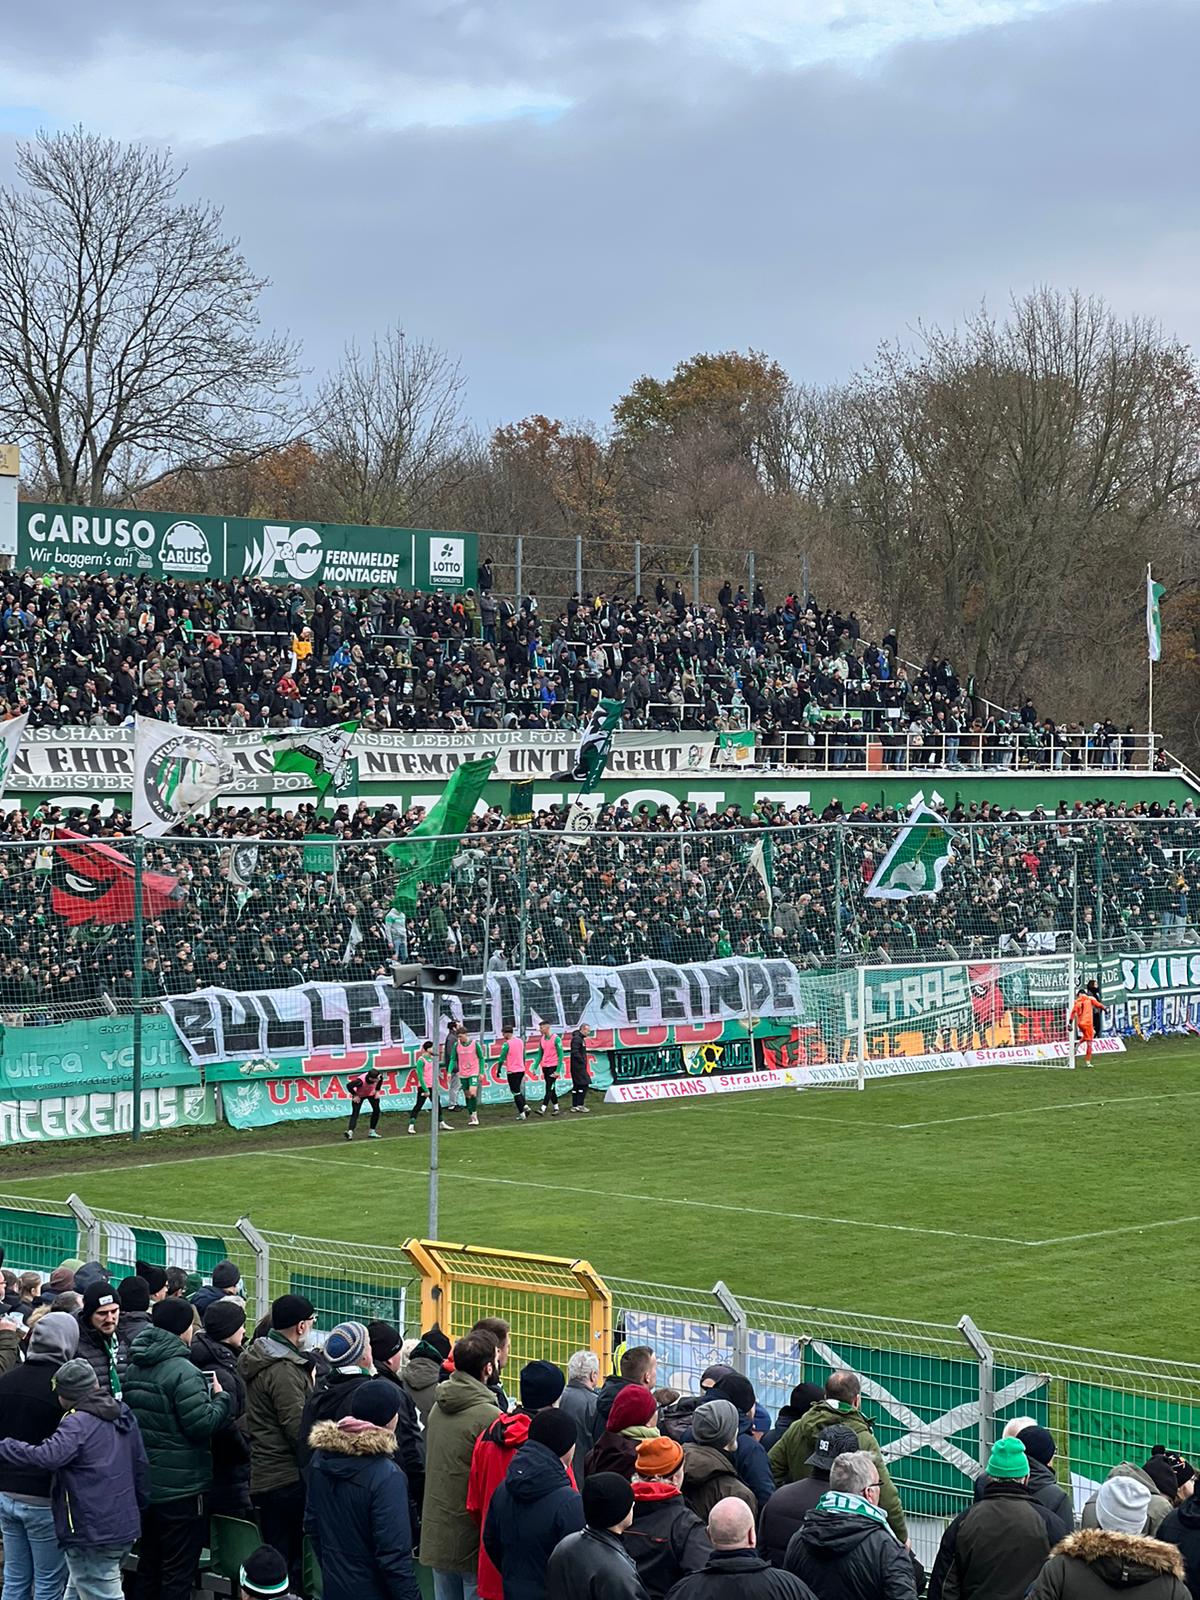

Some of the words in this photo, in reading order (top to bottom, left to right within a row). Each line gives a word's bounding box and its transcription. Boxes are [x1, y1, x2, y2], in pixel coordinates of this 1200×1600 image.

[28, 513, 155, 549] CARUSO
[29, 546, 51, 563] Wir
[114, 554, 133, 567] an!
[158, 550, 212, 565] CARUSO
[325, 550, 400, 568] FERNMELDE
[322, 568, 398, 584] MONTAGEN
[433, 561, 461, 573] LOTTO
[20, 727, 132, 741] NSCHAFT
[353, 733, 407, 747] NSER
[412, 733, 476, 747] LEBEN
[482, 732, 524, 746] NUR
[45, 747, 135, 774] EHR
[509, 747, 682, 772] UNTEGEHT
[5, 774, 134, 789] R-MEISTER
[272, 776, 315, 791] POK
[1121, 955, 1200, 991] SKINS
[617, 961, 796, 1023] FEINDE
[844, 965, 967, 1030] ULTRAS
[809, 1054, 956, 1081] www.tishlerei-thieme.de
